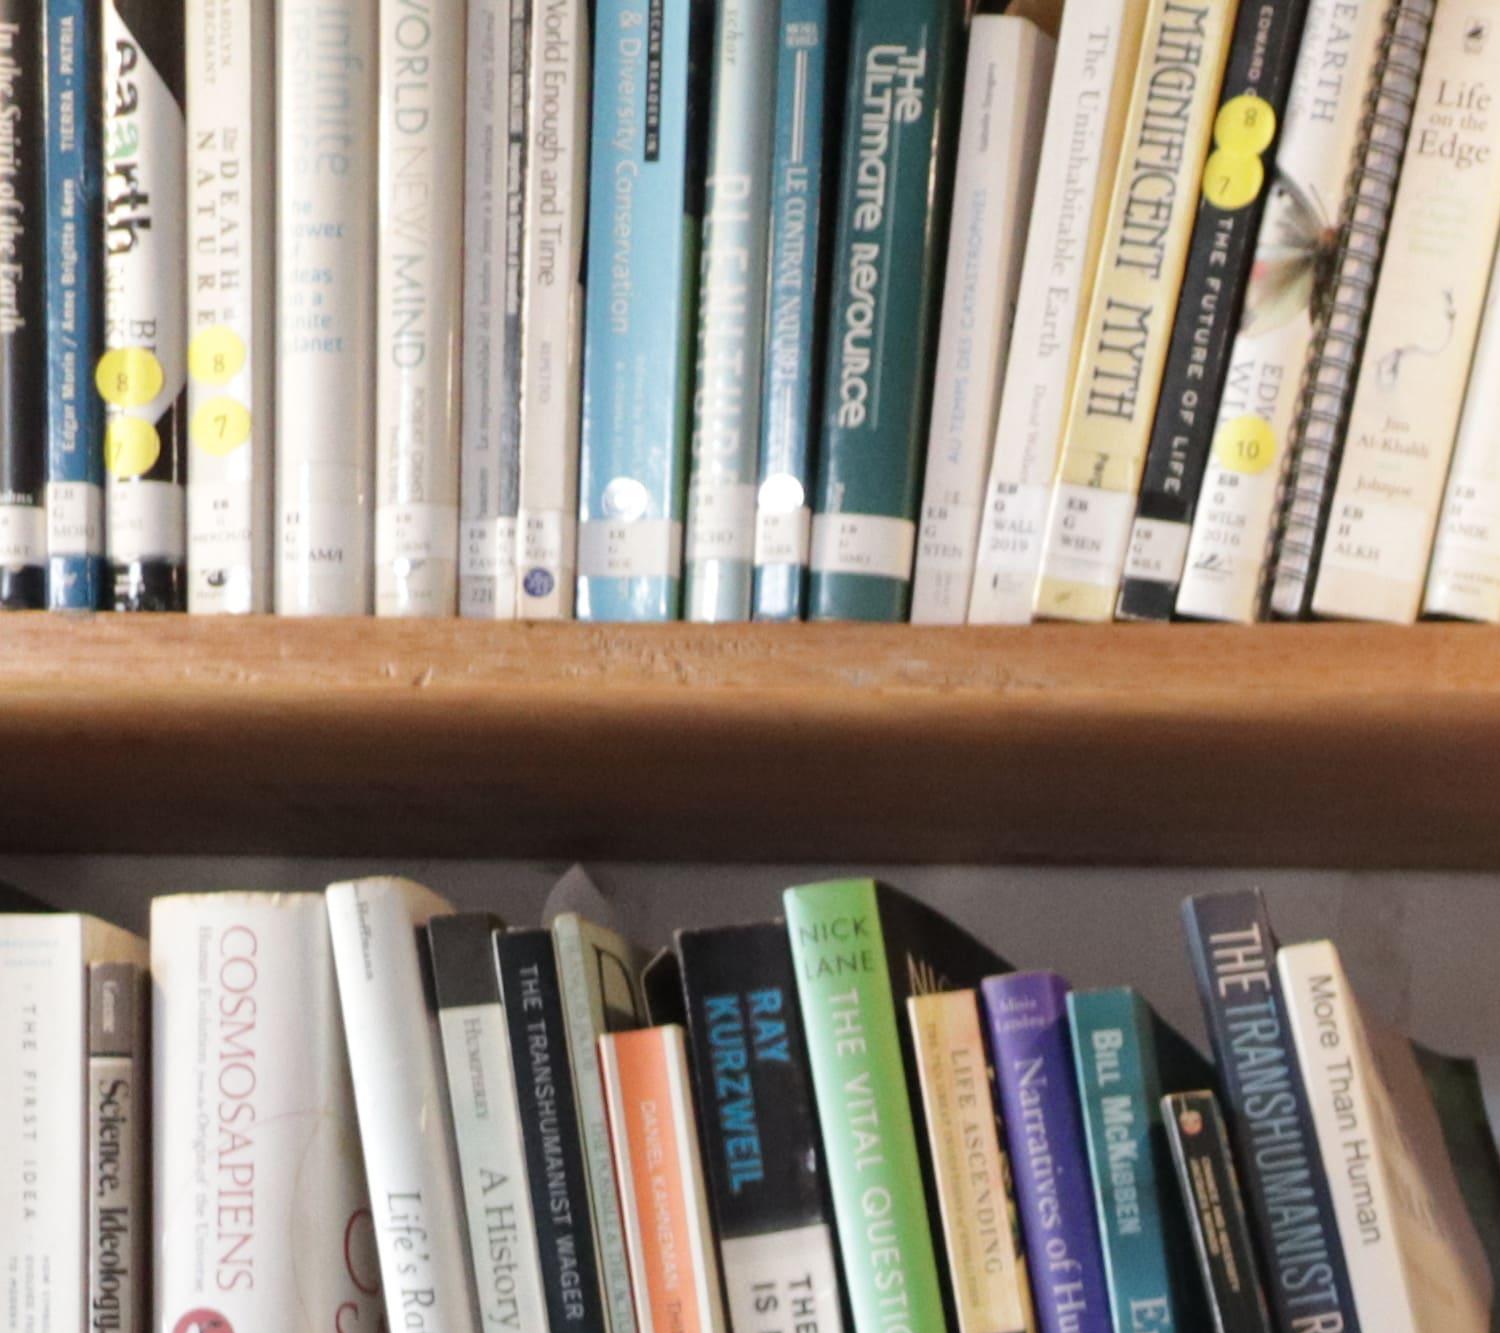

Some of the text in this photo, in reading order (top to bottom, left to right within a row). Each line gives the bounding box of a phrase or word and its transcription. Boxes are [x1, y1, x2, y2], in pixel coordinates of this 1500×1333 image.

[107, 39, 150, 255] eaarth
[612, 9, 640, 334] & Diversity Conservation
[1037, 25, 1110, 360] The Uninhabitable Earth
[1085, 3, 1210, 423] MAGNIFICENT MYTH
[392, 252, 426, 371] MIND
[1163, 216, 1234, 494] THE FUTURE OF LIFE
[1208, 922, 1271, 992] THE
[752, 988, 789, 1063] RAY
[827, 988, 865, 1057] THE
[96, 1079, 126, 1198] Science,
[218, 925, 254, 1294] COSMOSAPIENS
[704, 995, 760, 1192] KURZWEIL
[845, 1071, 889, 1171] VITAL
[1224, 998, 1339, 1310] TRANSHUMANIST
[1308, 974, 1383, 1246] More Than Human
[387, 1190, 427, 1278] Life's
[480, 1167, 510, 1195] A
[484, 1204, 525, 1327] History
[754, 1283, 782, 1314] IS
